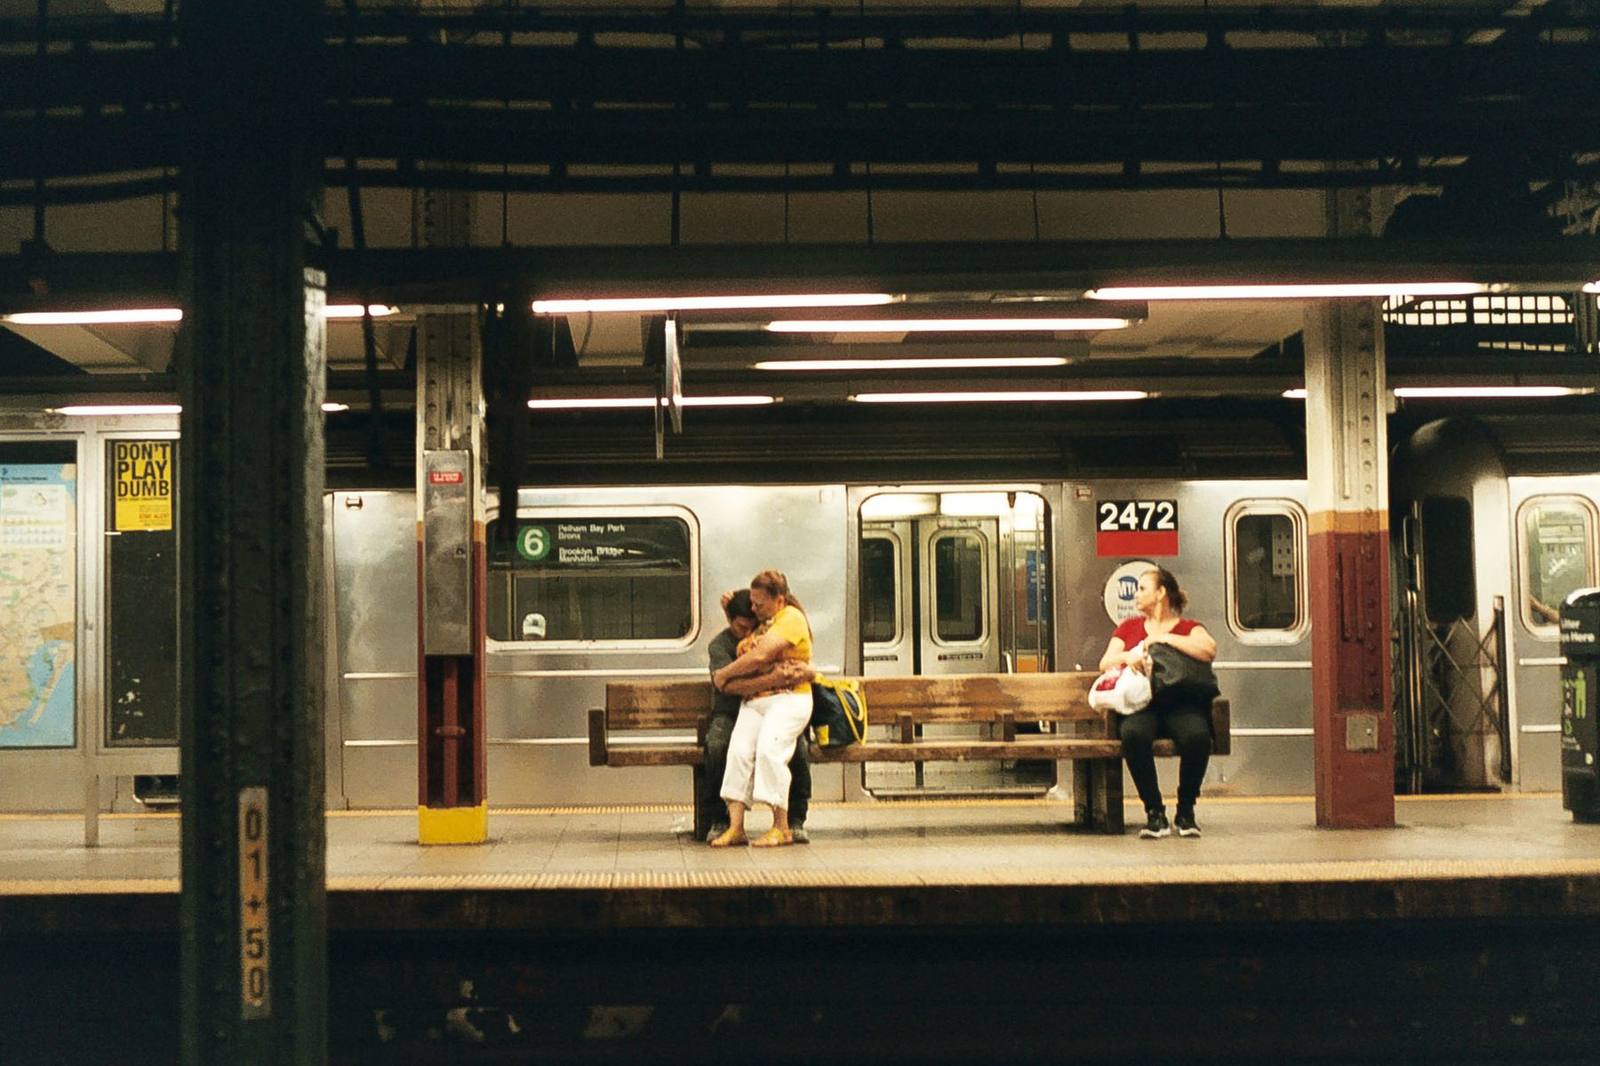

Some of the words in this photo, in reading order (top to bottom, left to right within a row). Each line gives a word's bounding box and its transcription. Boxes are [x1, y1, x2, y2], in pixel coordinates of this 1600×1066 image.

[117, 443, 169, 460] DON'T
[118, 461, 167, 480] PLAY
[118, 480, 169, 497] DUMB
[1100, 501, 1175, 531] 2472
[558, 524, 587, 533] Pelham
[590, 523, 604, 534] Bay
[607, 523, 625, 533] Park
[524, 528, 544, 556] 6
[559, 553, 600, 563] Manhattan
[1570, 631, 1595, 643] Here
